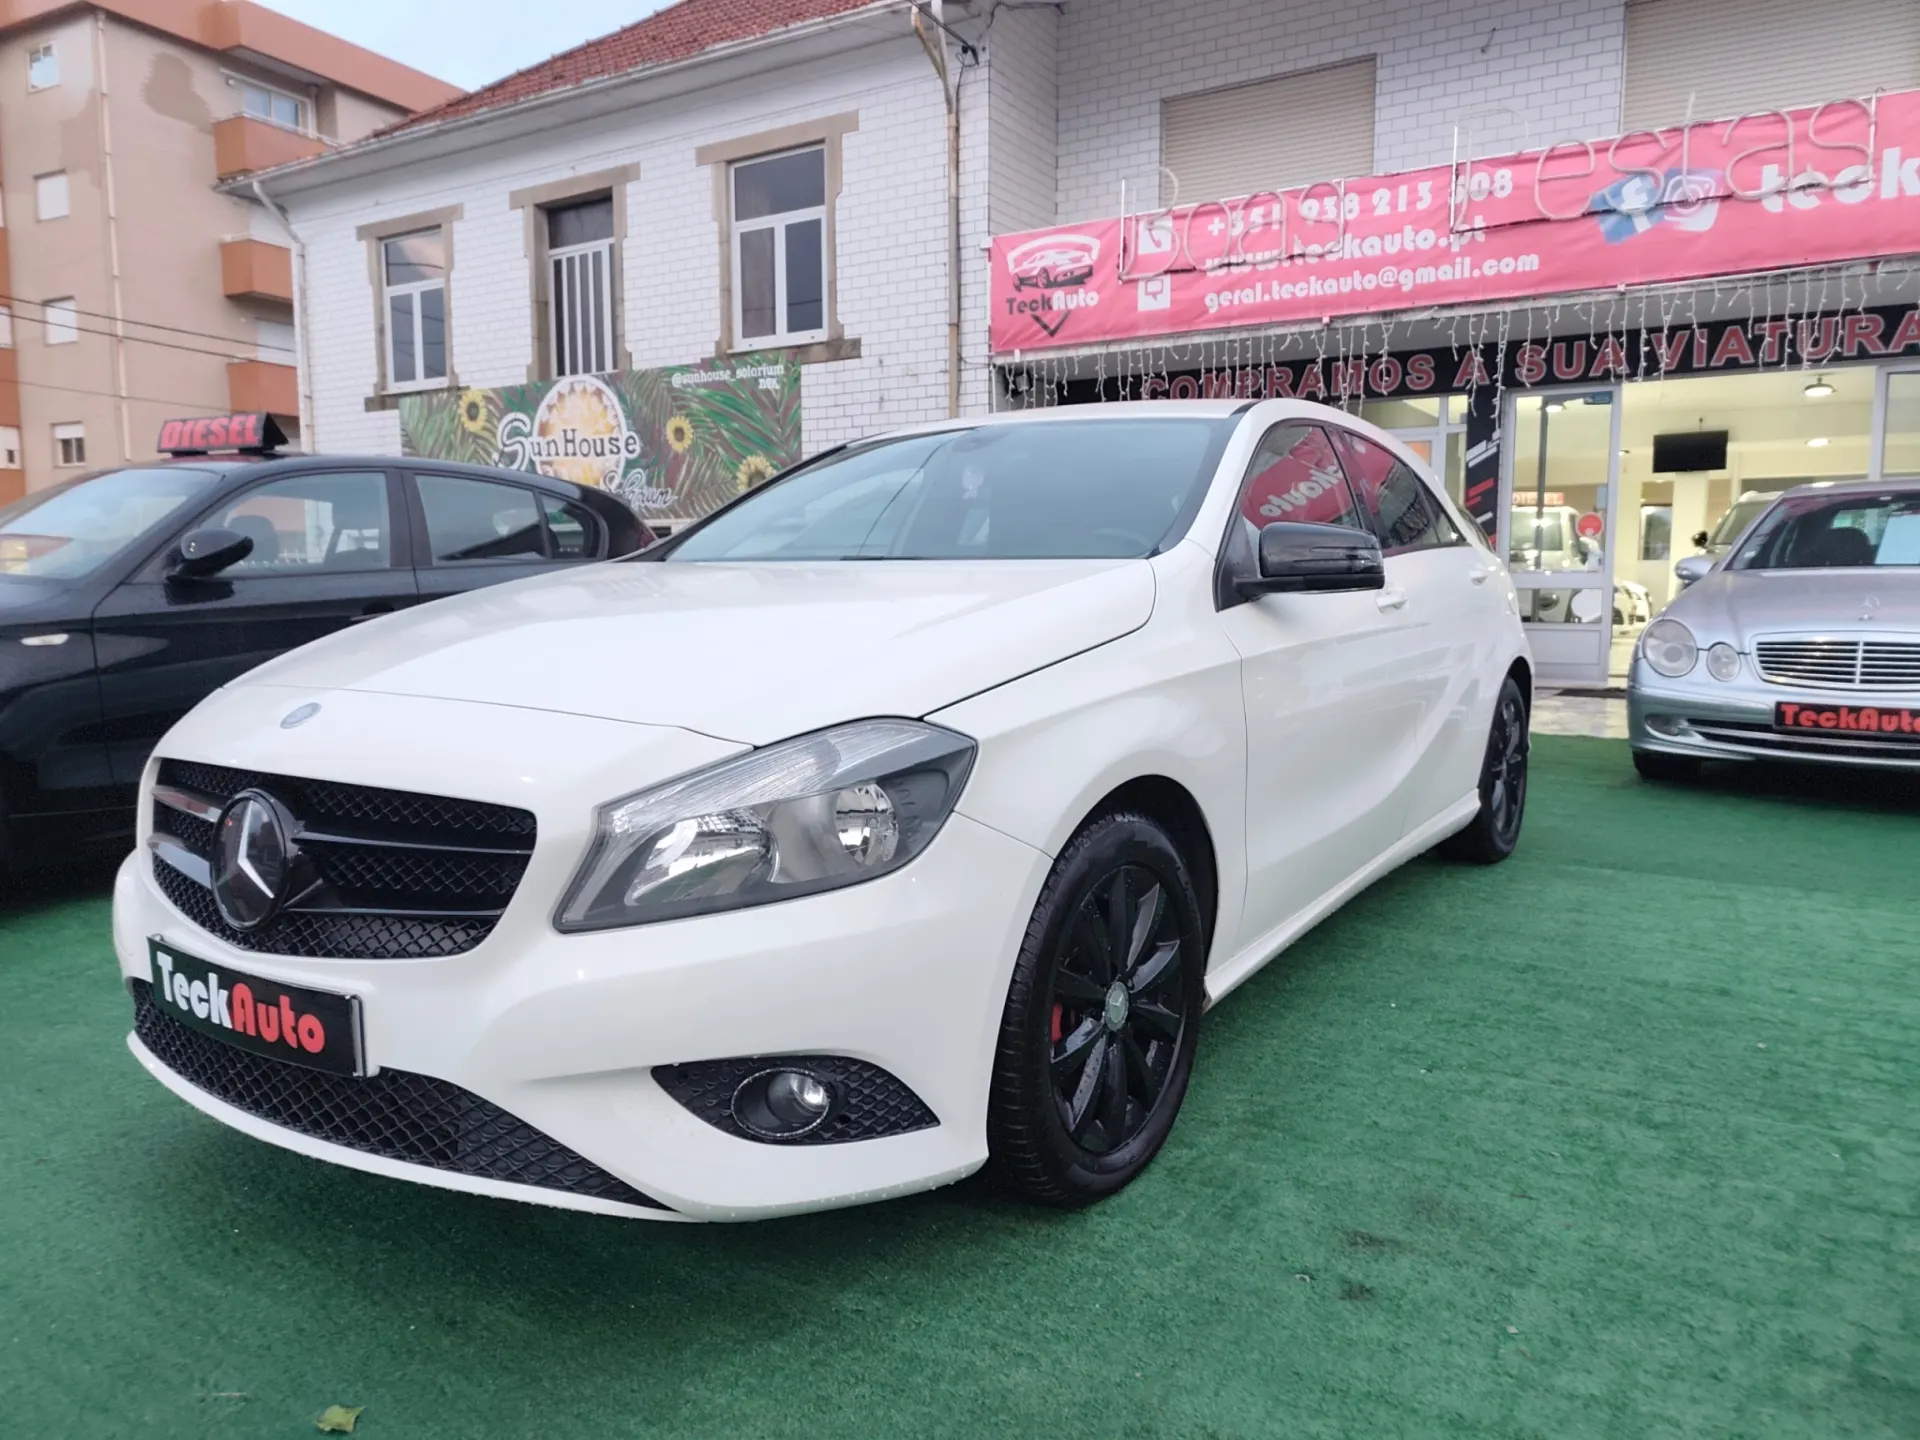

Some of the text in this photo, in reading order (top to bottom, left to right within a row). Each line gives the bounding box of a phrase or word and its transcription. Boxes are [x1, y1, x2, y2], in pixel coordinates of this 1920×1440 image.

[1300, 192, 1360, 226] 938
[1372, 181, 1433, 216] 213
[1006, 288, 1099, 315] TeckAuto
[1204, 253, 1540, 313] geral.teckauto@gmail.com
[1144, 354, 1435, 400] COMPRAMOS
[1453, 351, 1490, 388] A
[1515, 339, 1630, 382] SUA
[161, 414, 261, 449] DIESEL
[494, 413, 640, 471] SunHouse
[156, 952, 325, 1053] TeckAuto
